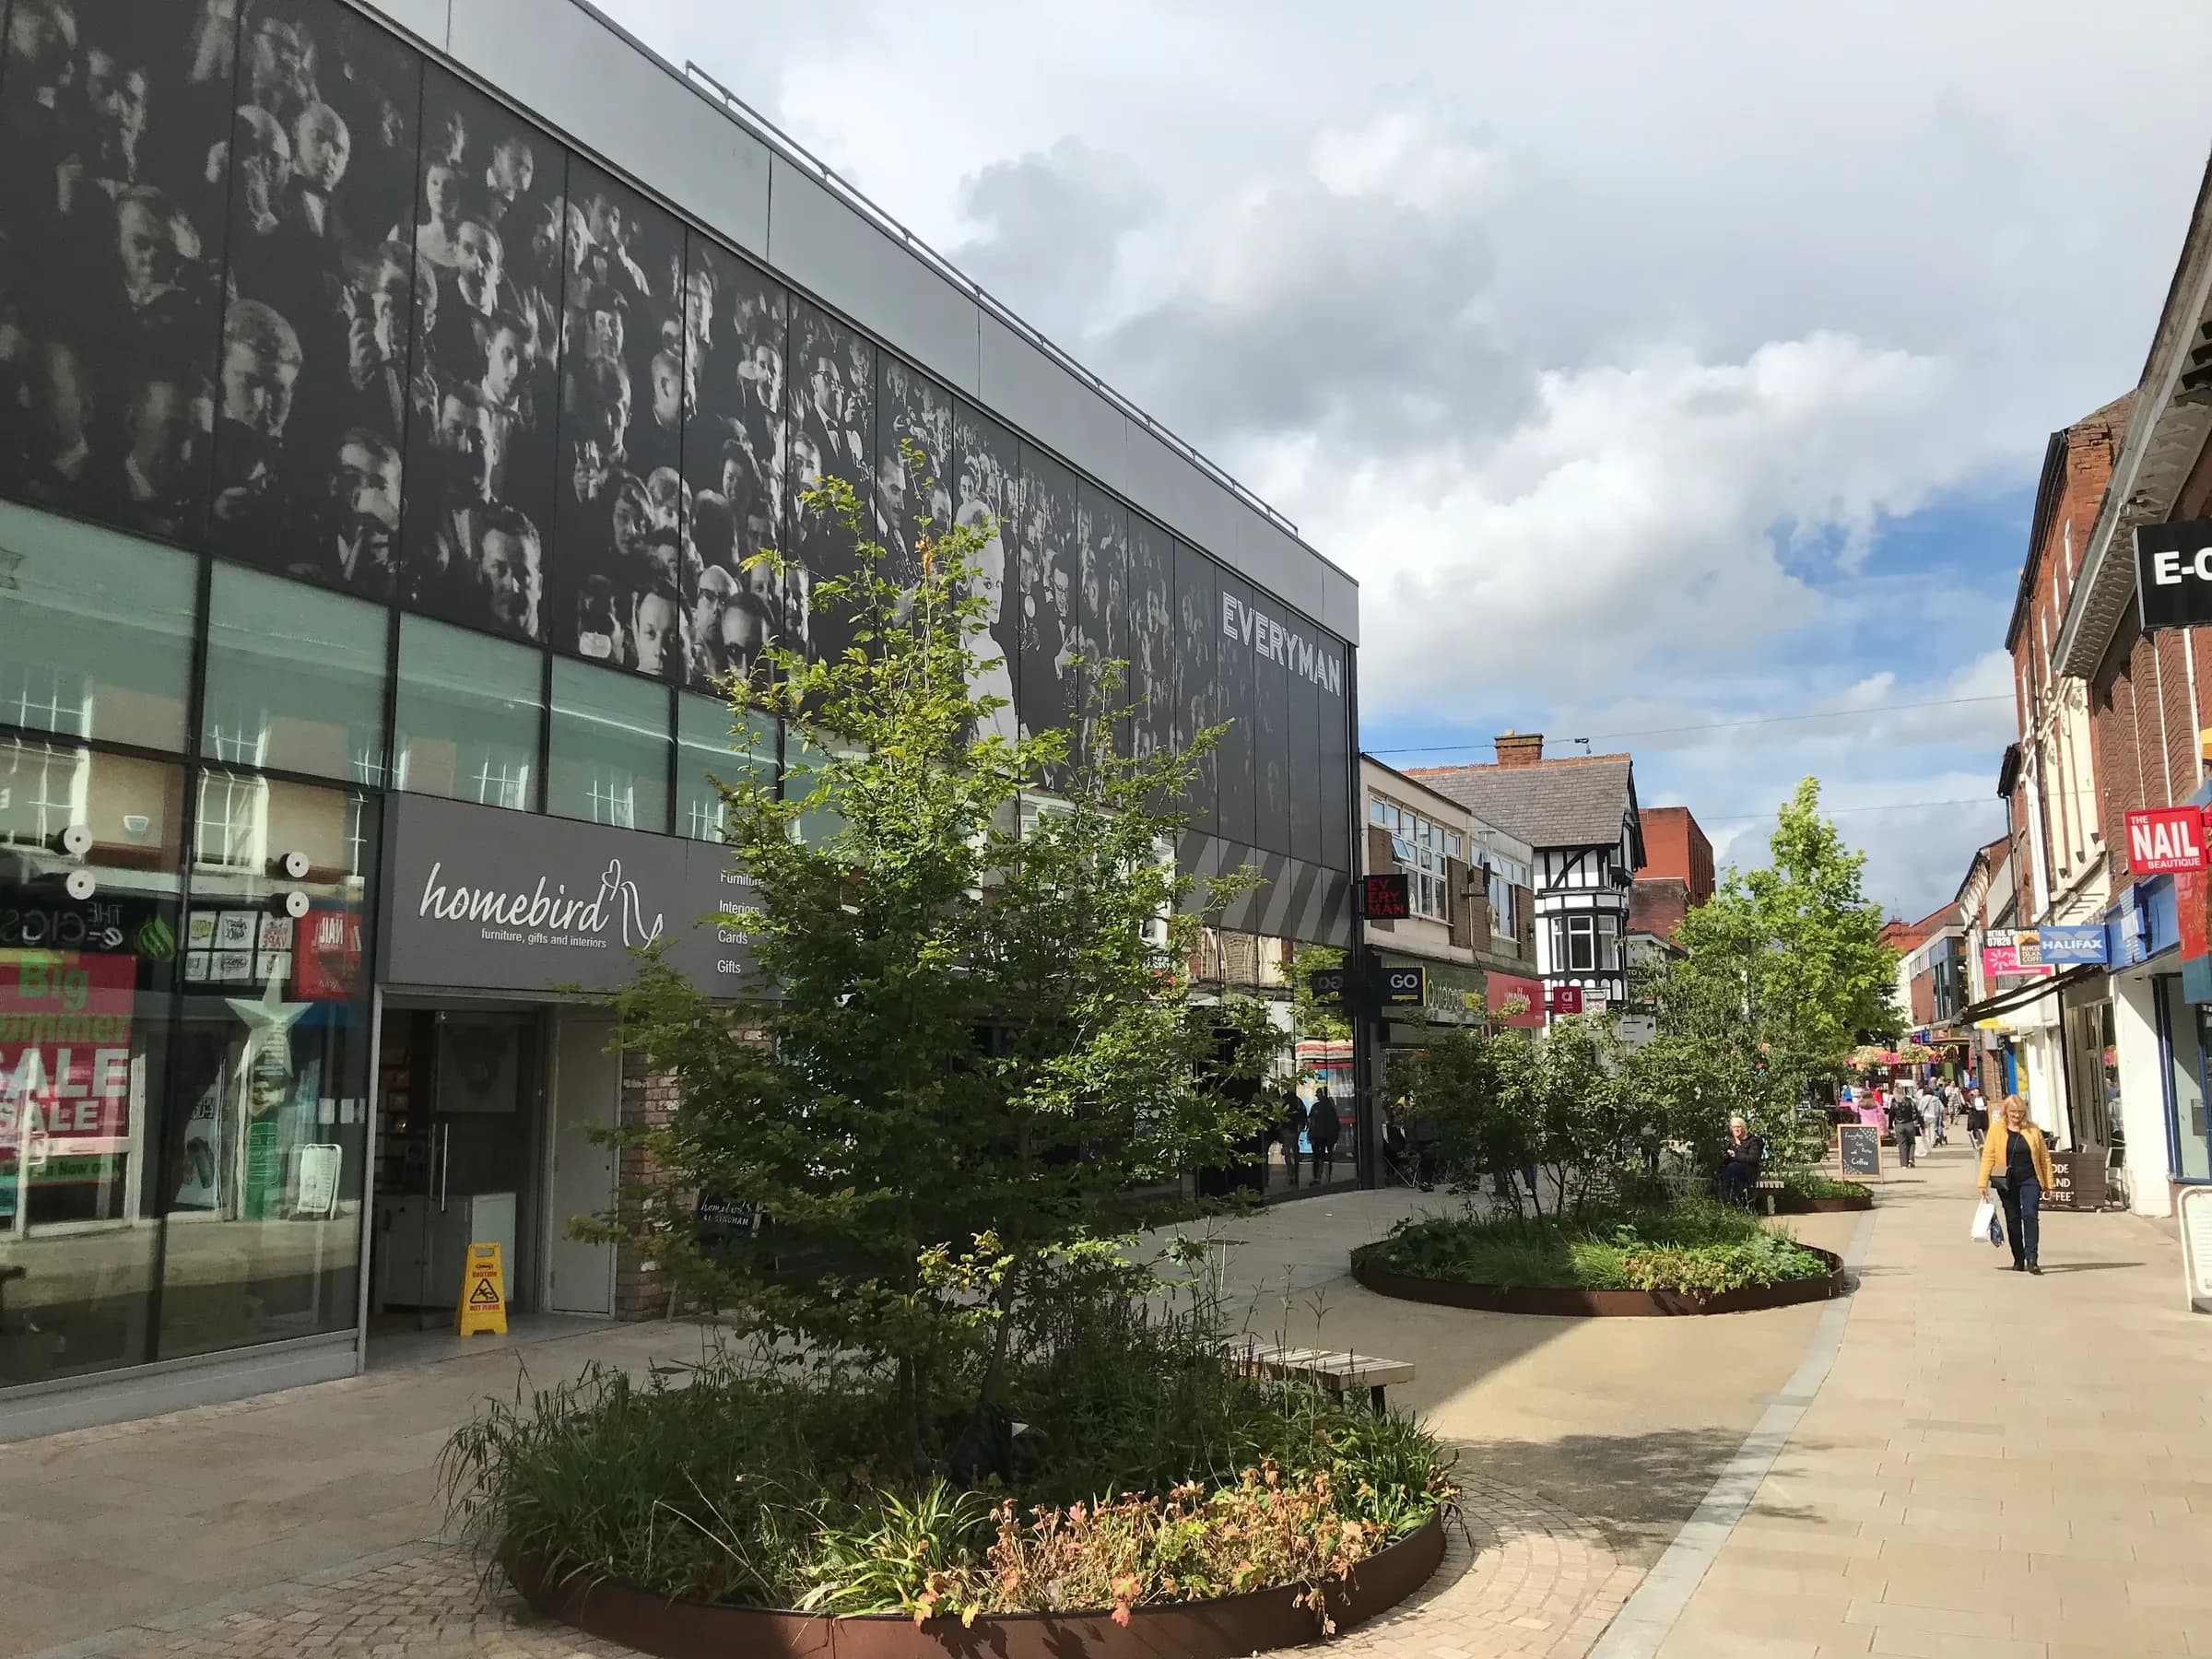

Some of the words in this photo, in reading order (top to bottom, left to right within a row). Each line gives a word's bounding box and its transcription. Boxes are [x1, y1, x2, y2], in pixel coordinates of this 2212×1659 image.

[1222, 591, 1341, 697] EVERYMAN
[2130, 816, 2148, 826] THE
[2131, 820, 2200, 861] NAIL
[2147, 857, 2202, 870] BEAUTIQUE
[1368, 878, 1390, 891] EV
[419, 862, 610, 933] homebird
[1368, 890, 1401, 904] ERY
[720, 900, 760, 914] Interiors
[1369, 902, 1404, 915] MAN
[481, 927, 525, 945] furniture,
[527, 932, 548, 947] gifts
[550, 935, 568, 947] and
[570, 935, 607, 949] interiors
[718, 929, 748, 945] Cards
[2041, 939, 2103, 950] HALIFAX
[717, 959, 741, 974] Gifts
[18, 953, 89, 1011] Big
[1390, 973, 1418, 989] GO
[0, 1048, 130, 1099] ALE
